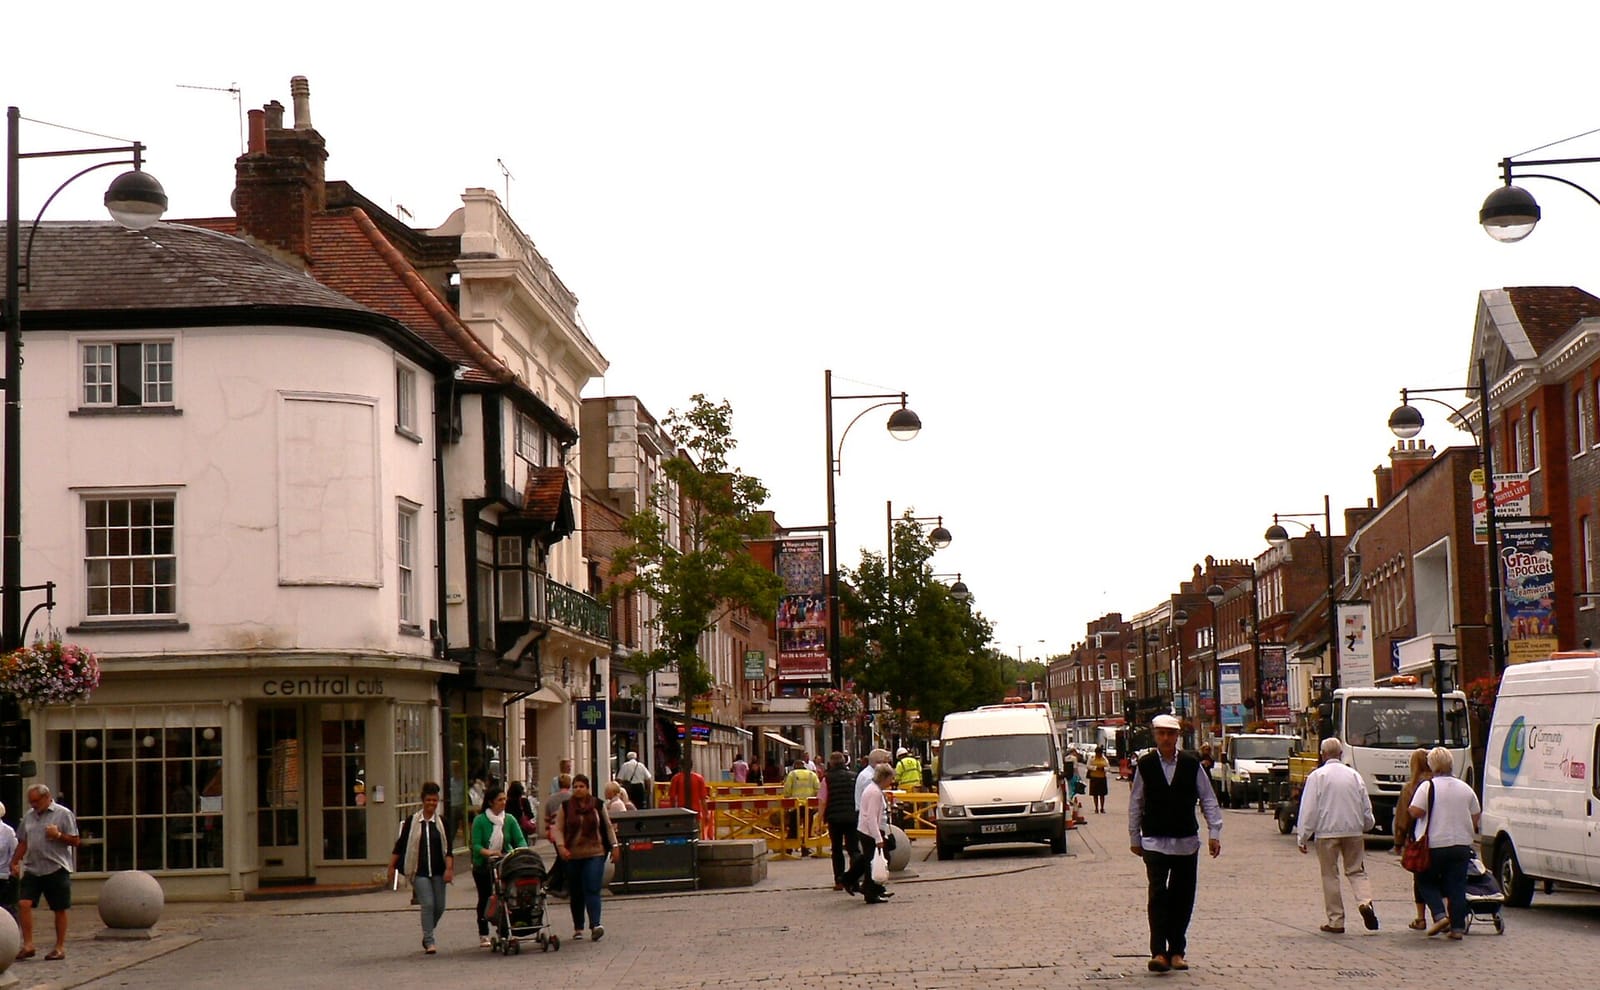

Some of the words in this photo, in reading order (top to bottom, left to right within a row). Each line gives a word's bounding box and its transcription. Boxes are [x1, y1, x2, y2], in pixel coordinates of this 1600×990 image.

[1514, 485, 1527, 494] LEFT
[1510, 532, 1529, 540] magical
[263, 674, 349, 695] central
